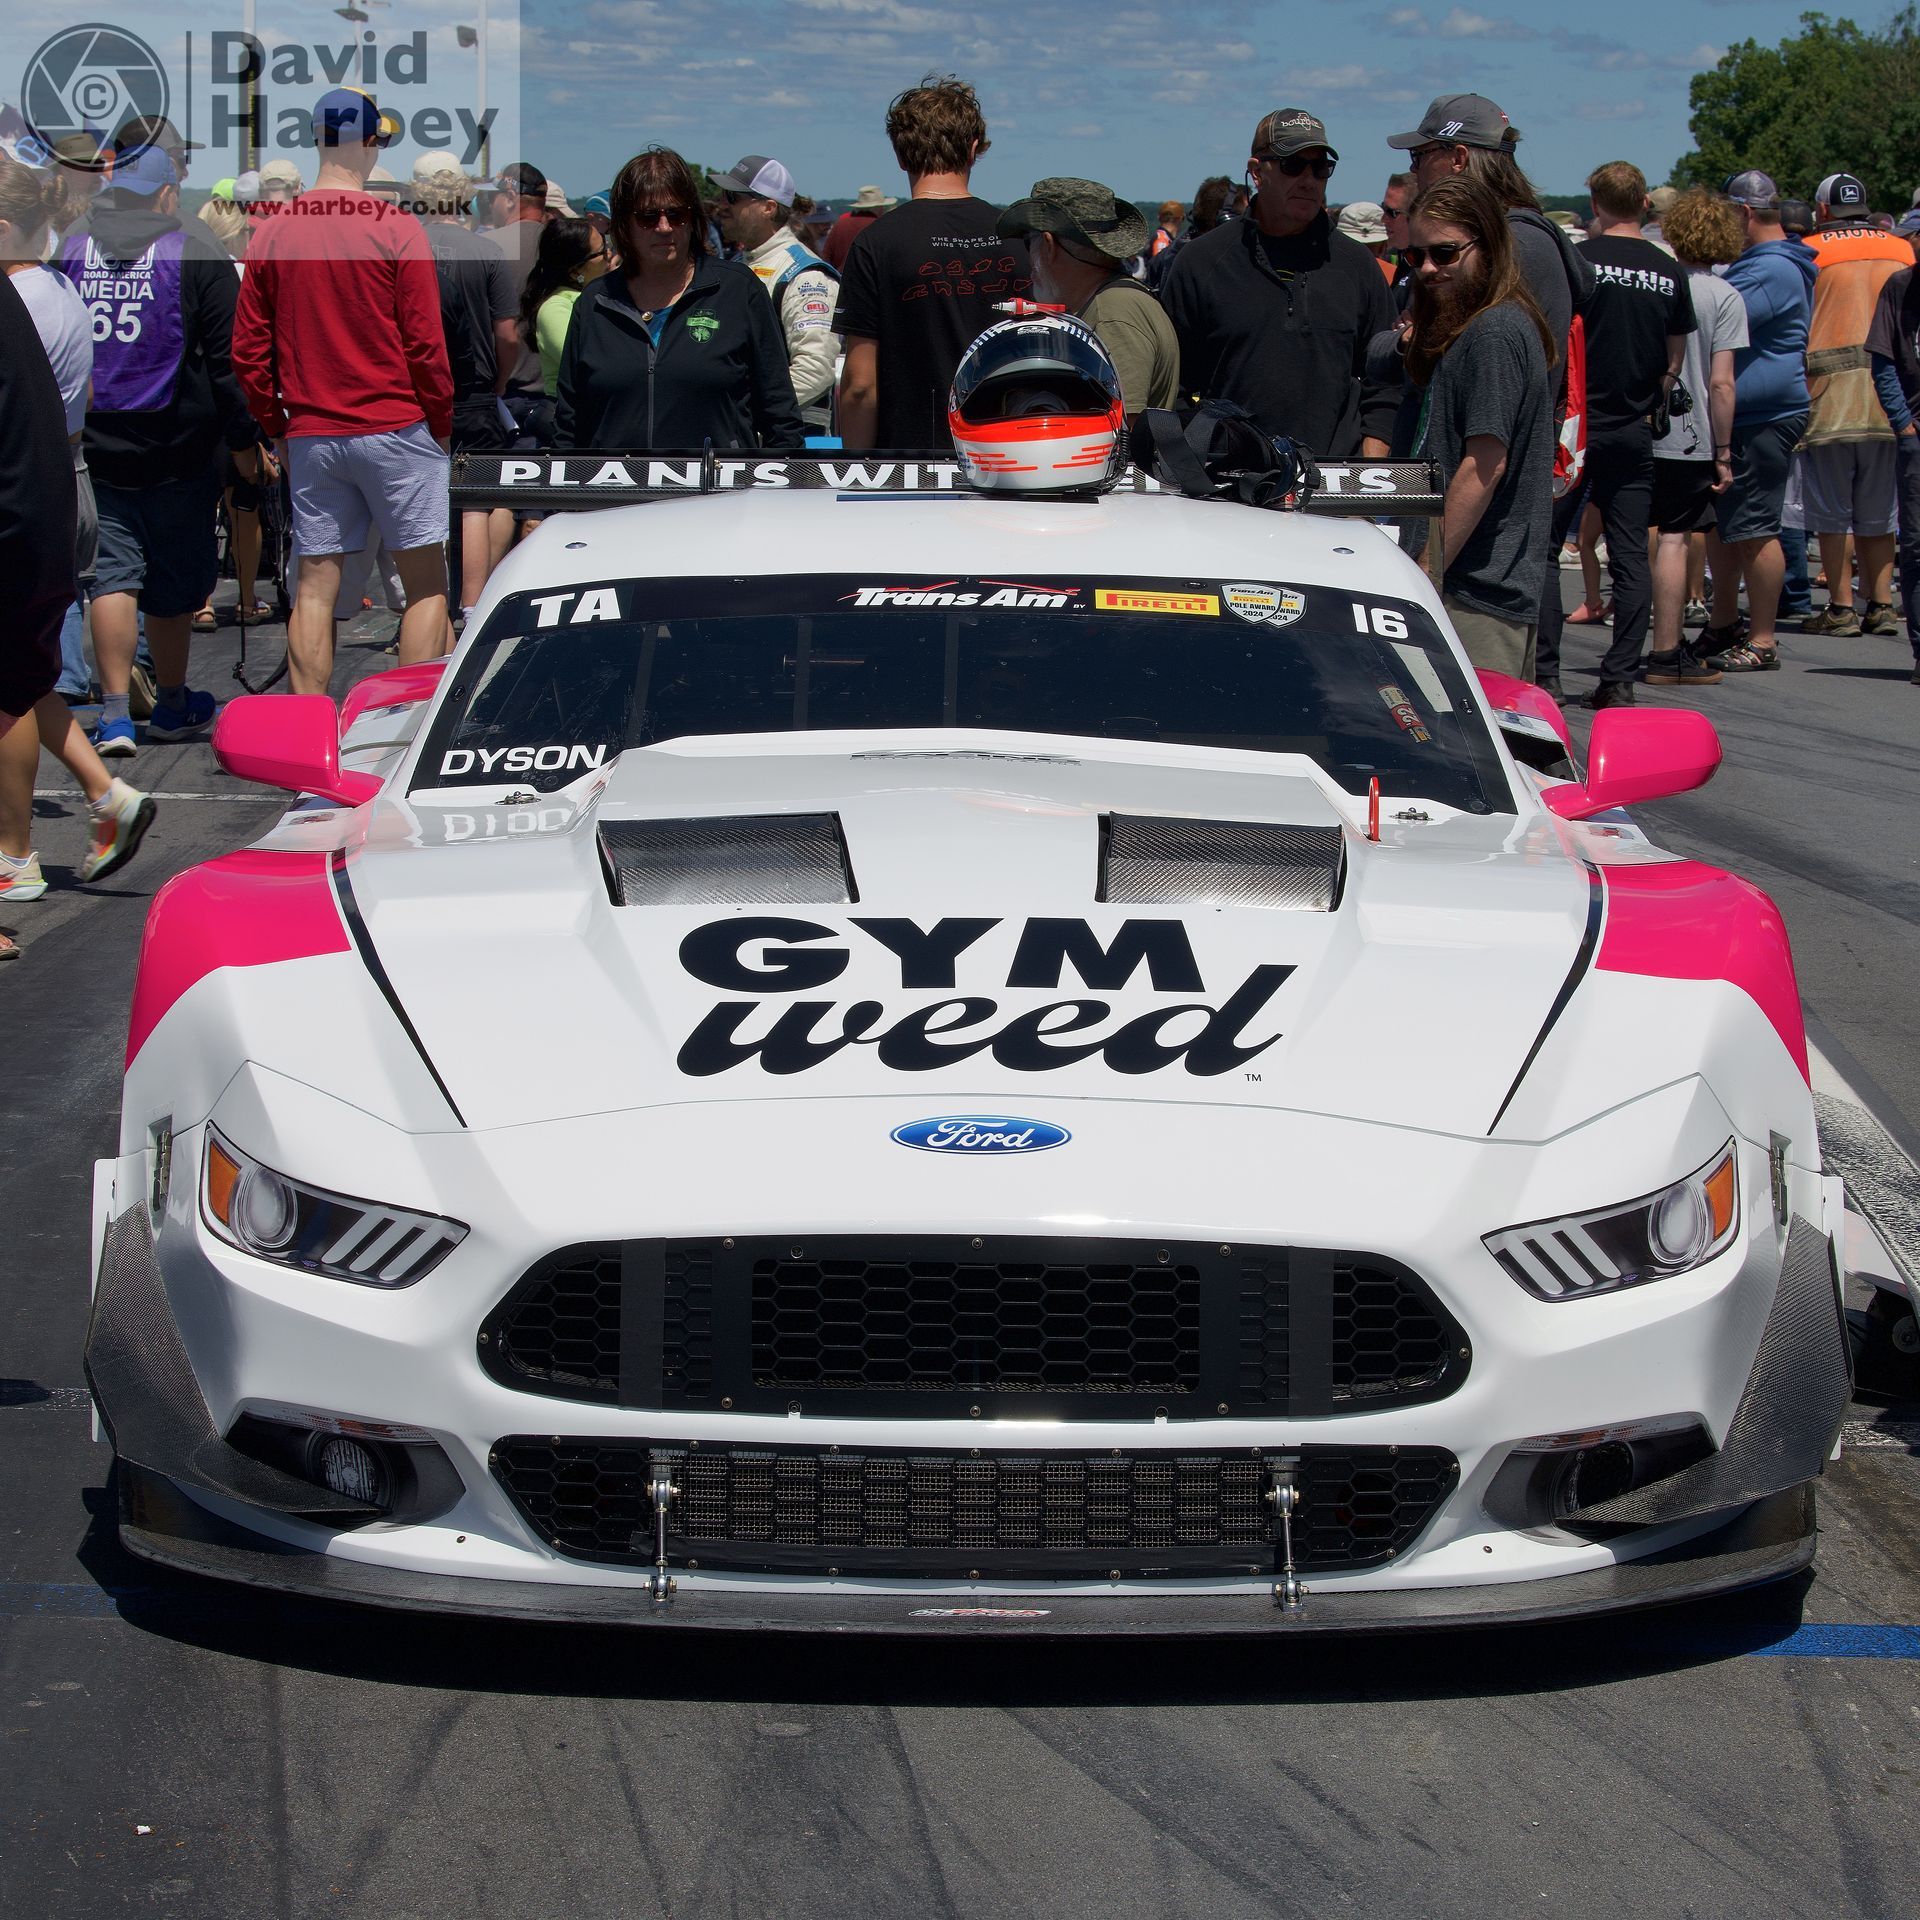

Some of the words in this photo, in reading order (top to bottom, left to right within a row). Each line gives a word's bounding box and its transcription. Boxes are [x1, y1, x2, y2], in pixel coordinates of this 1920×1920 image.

[1438, 121, 1463, 137] 20
[973, 240, 1002, 248] COME
[83, 271, 109, 279] ROAD
[1595, 264, 1674, 288] Burtin
[80, 280, 155, 301] MEDIA
[87, 300, 142, 343] 65
[499, 460, 791, 487] PLANTS
[818, 463, 963, 488] WIT
[530, 588, 622, 628] TA
[853, 587, 979, 608] Trans
[980, 587, 1068, 608] Am
[1106, 593, 1207, 612] PIRELLI
[1249, 603, 1276, 611] AWARD
[1352, 603, 1409, 639] 16
[439, 744, 608, 776] DYSON
[678, 916, 1206, 993] GYM
[676, 964, 1299, 1078] weed
[926, 1119, 1034, 1151] Ford
